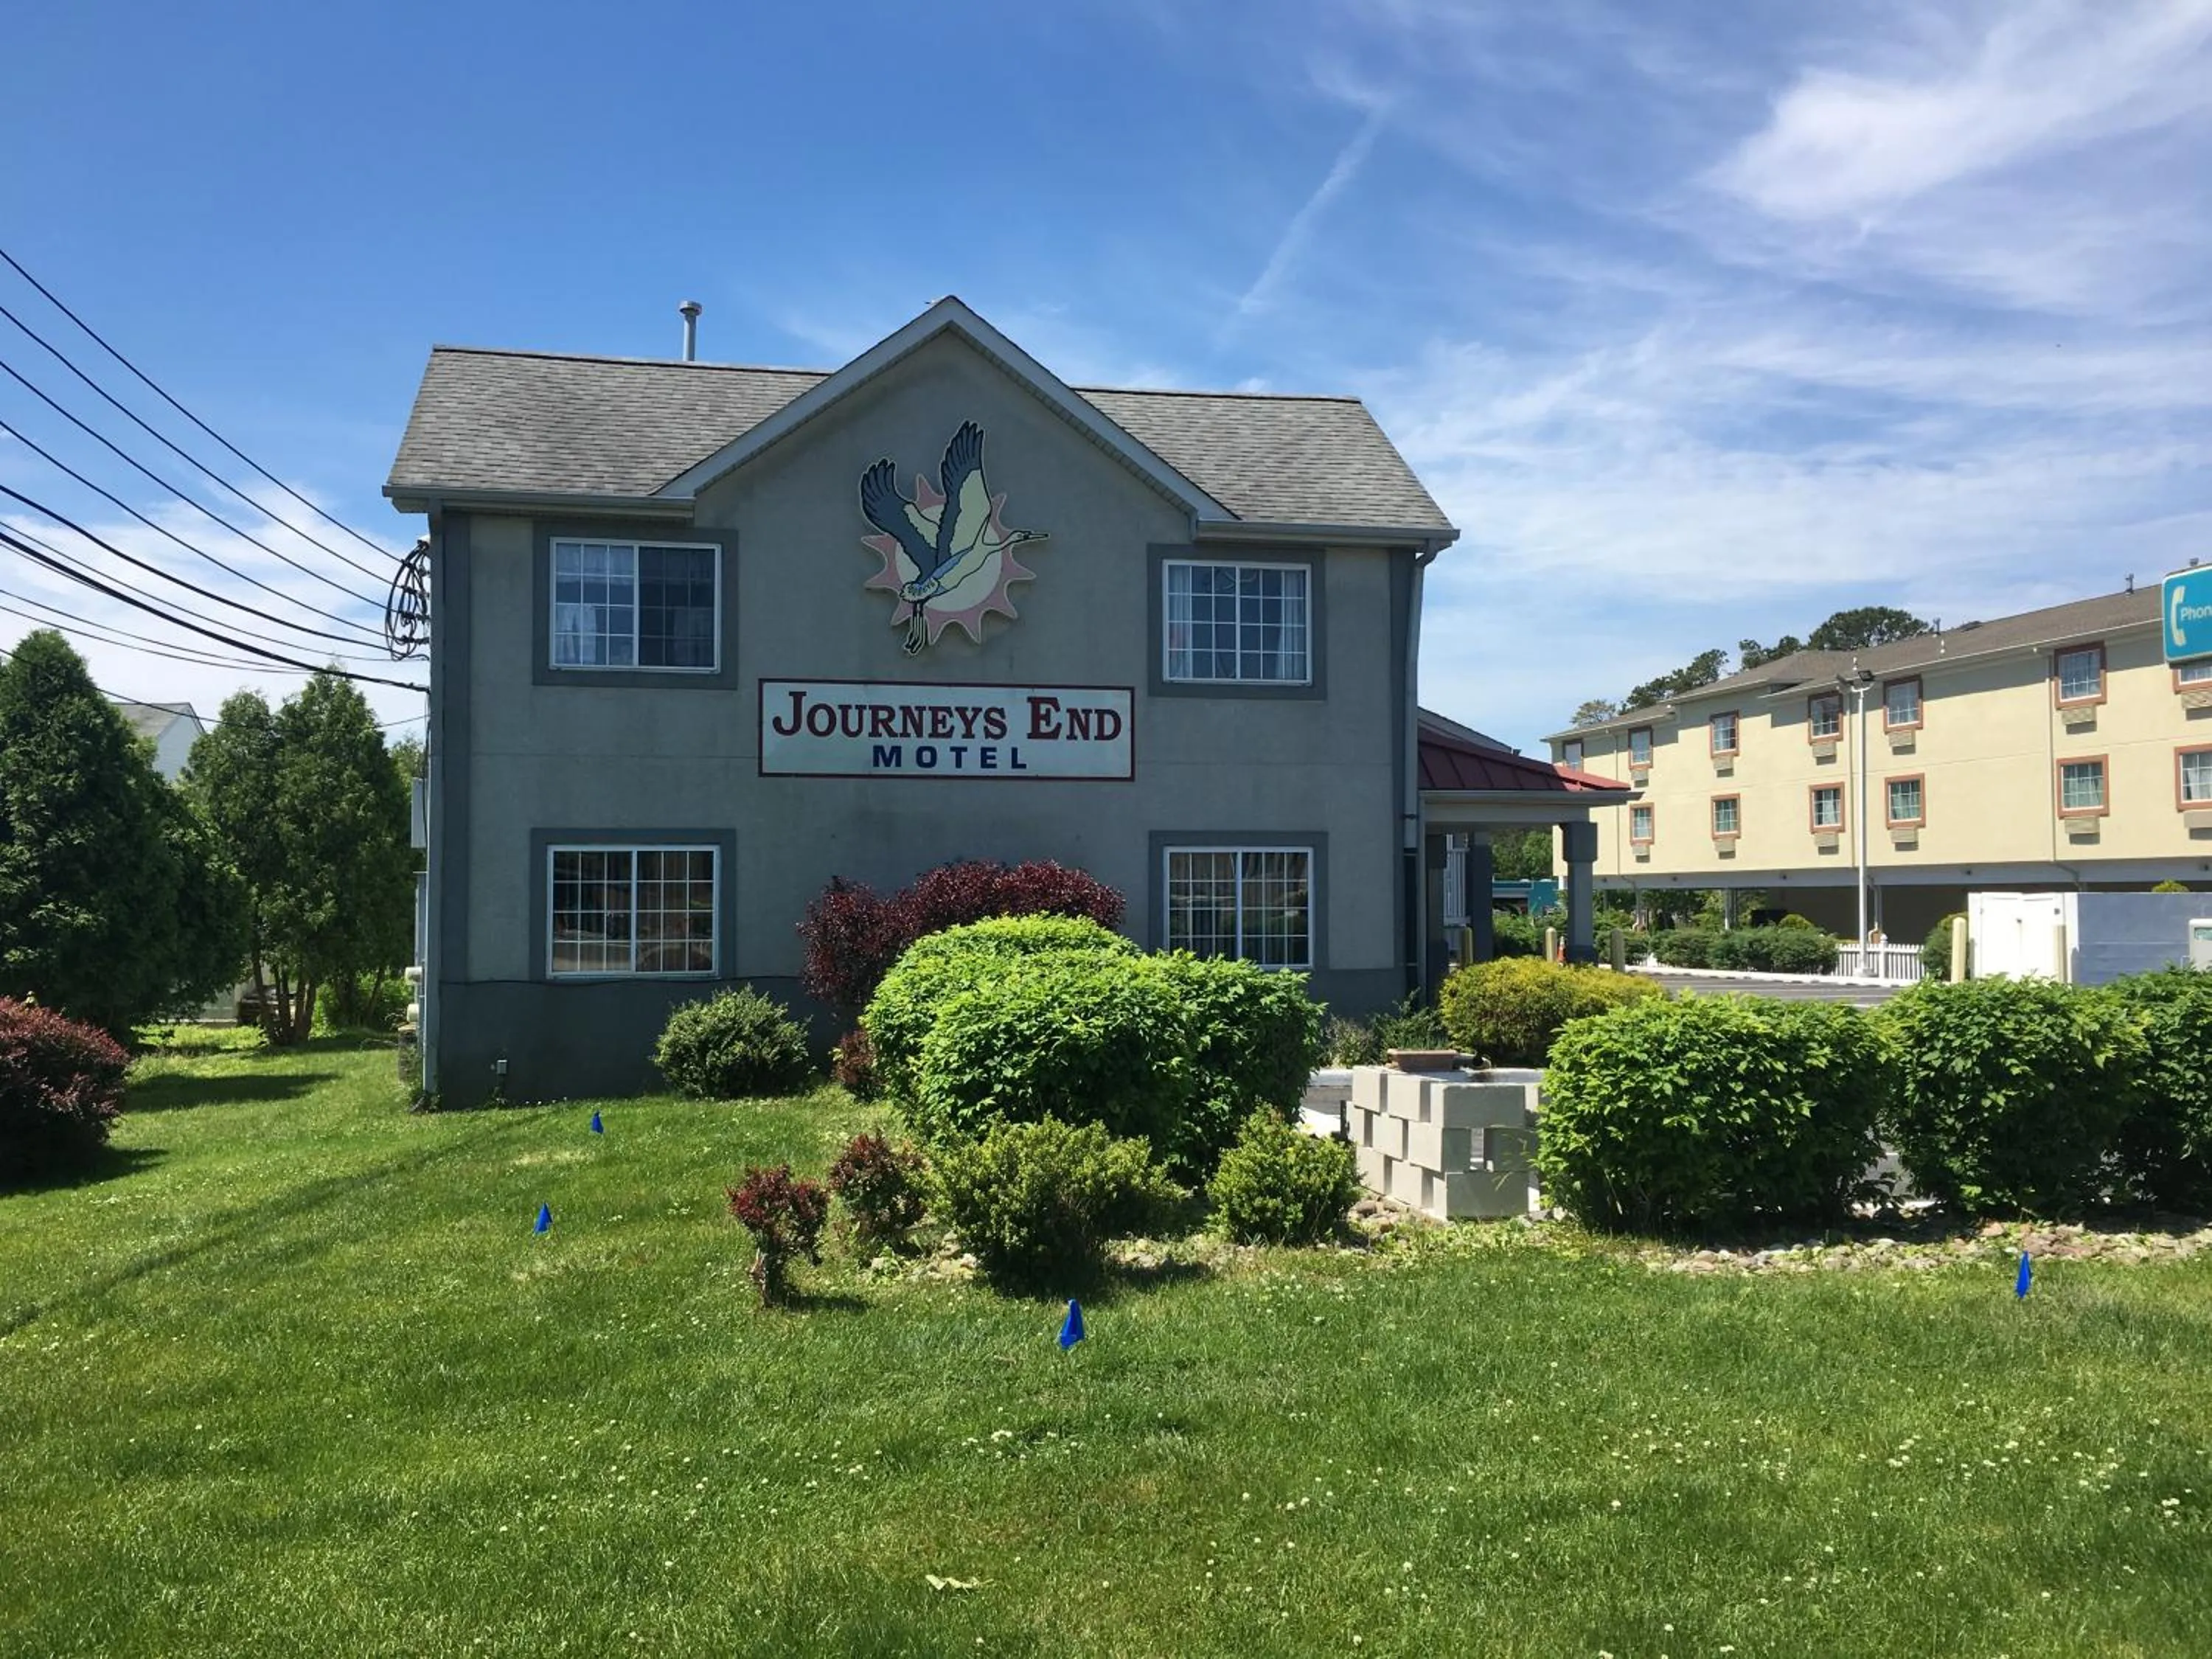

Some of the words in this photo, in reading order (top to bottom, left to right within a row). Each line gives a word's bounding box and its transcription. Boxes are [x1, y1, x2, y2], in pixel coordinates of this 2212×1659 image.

[772, 690, 1008, 741] JOURNEYS
[1026, 695, 1122, 742] END
[872, 744, 1027, 770] MOTEL
